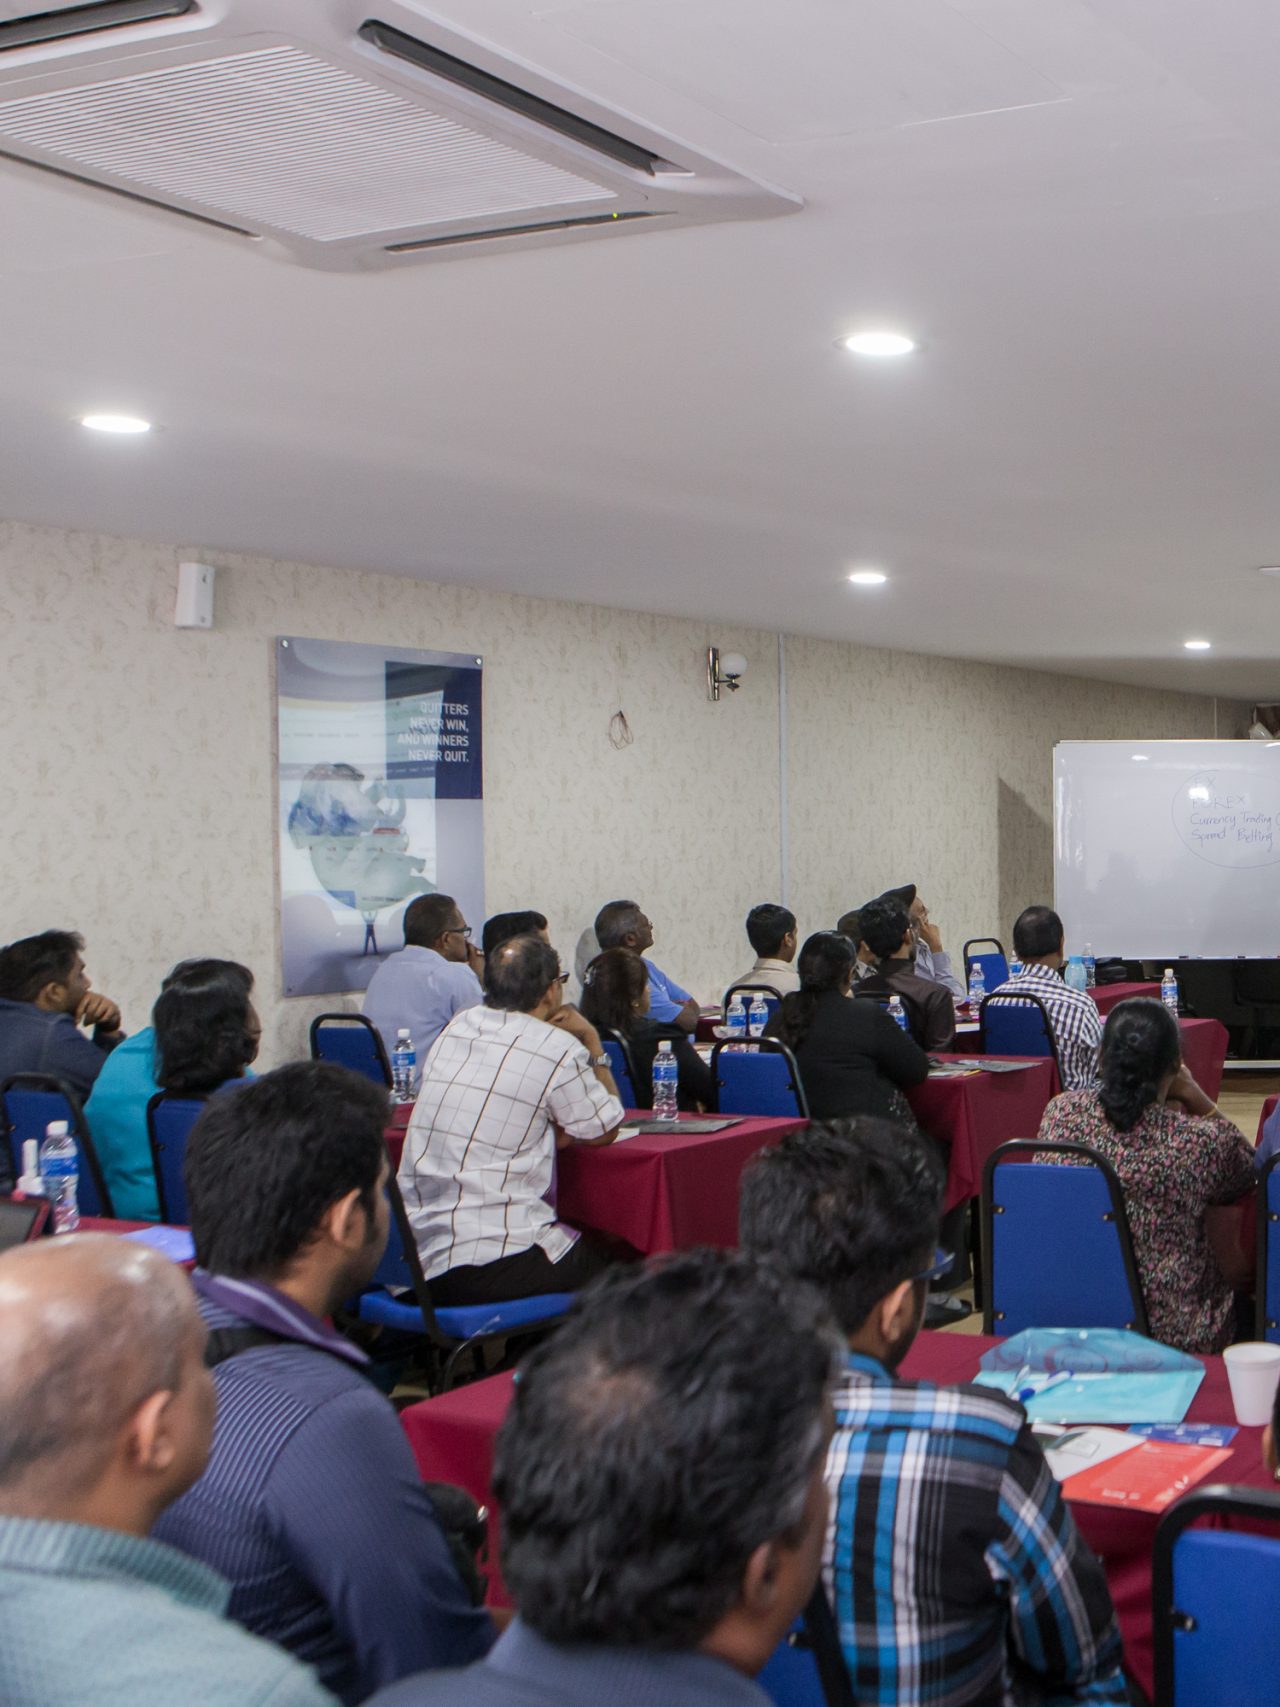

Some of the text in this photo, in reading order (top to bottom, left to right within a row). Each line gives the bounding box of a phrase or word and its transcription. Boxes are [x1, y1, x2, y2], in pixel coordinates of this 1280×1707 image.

[420, 701, 469, 716] QUITTERS
[409, 716, 469, 733] NEVER WIN,
[397, 733, 469, 747] AND WINNERS
[408, 749, 469, 762] NEVER QUIT.
